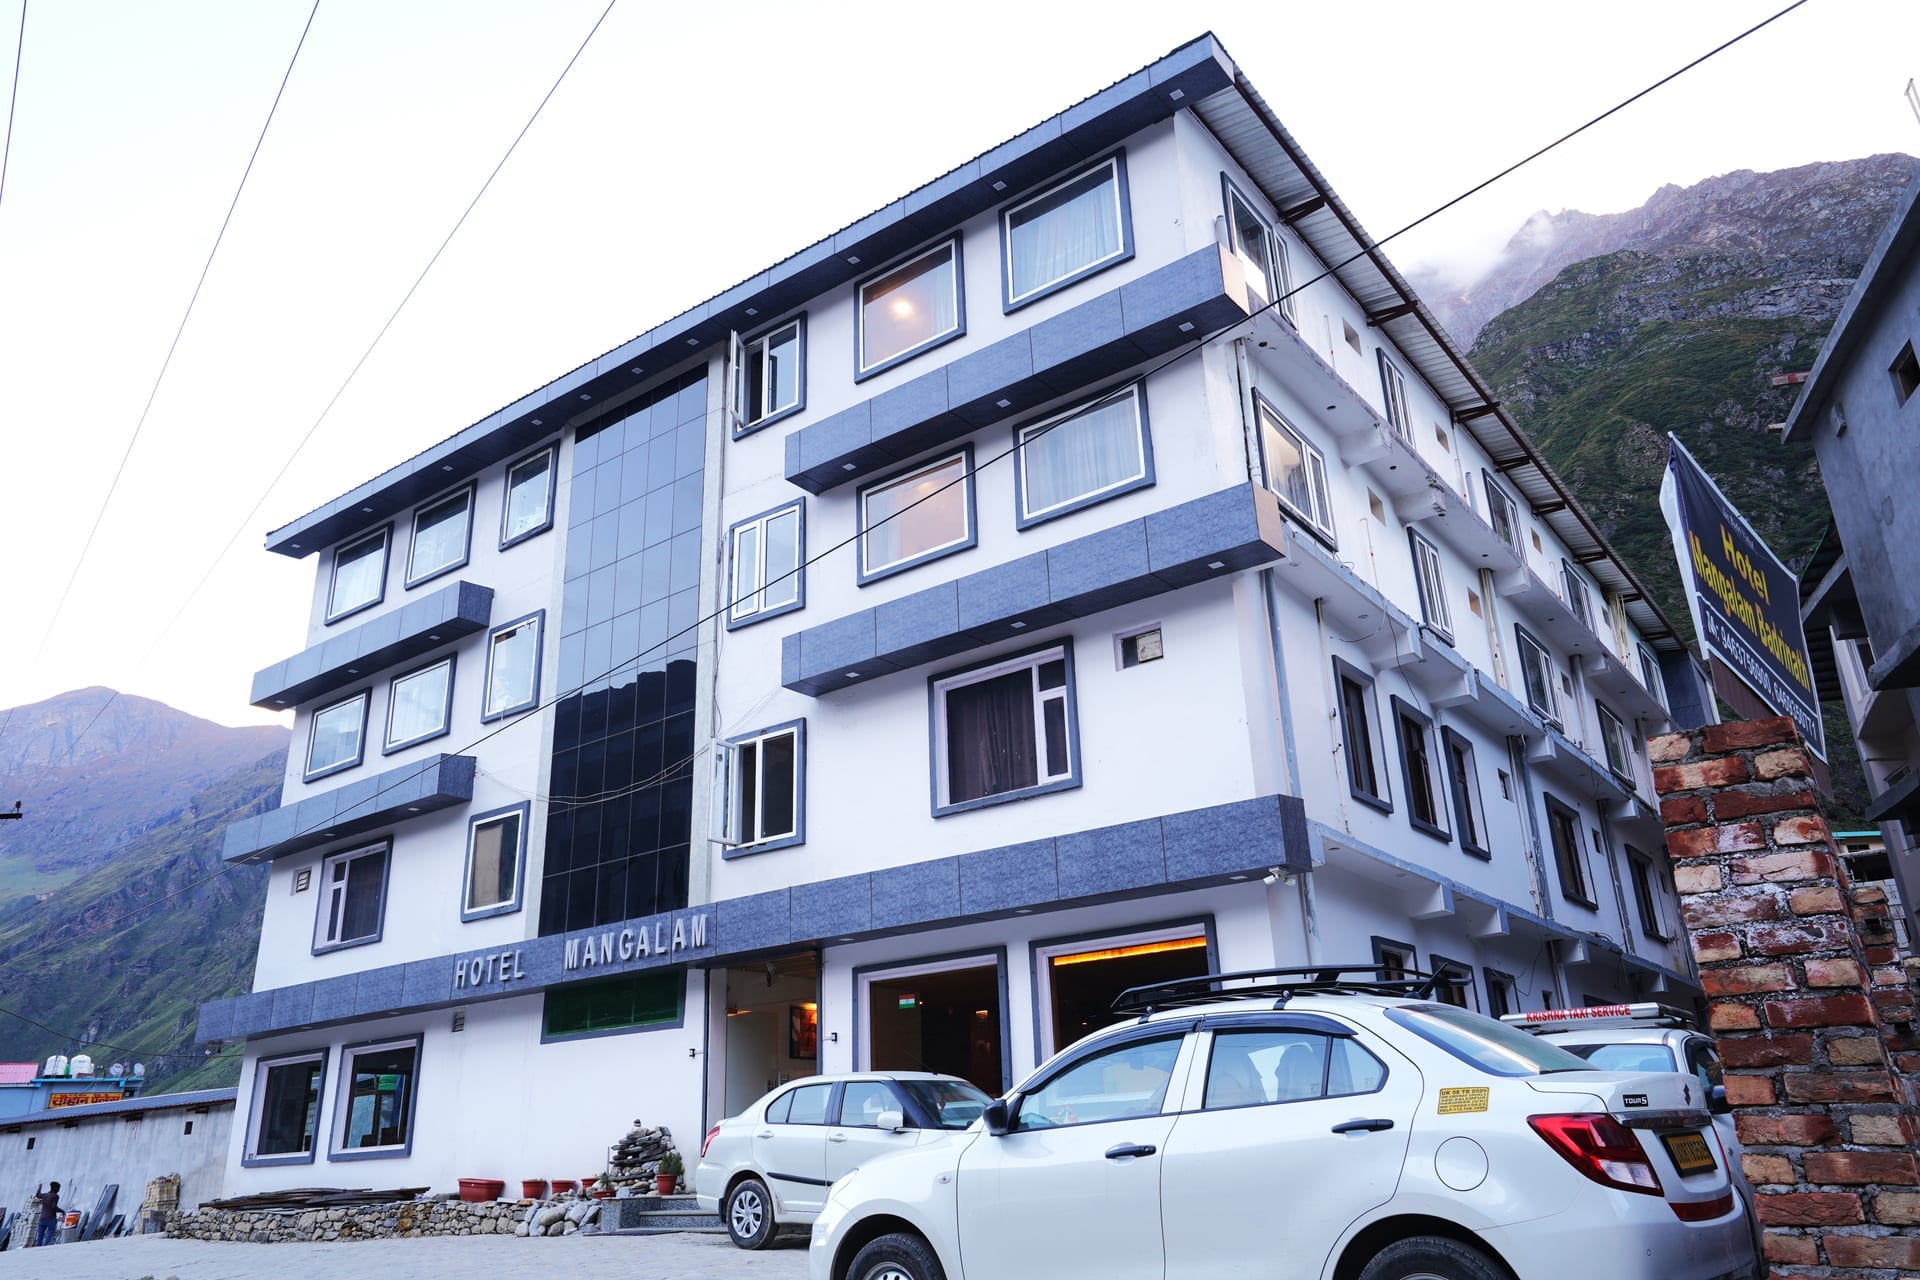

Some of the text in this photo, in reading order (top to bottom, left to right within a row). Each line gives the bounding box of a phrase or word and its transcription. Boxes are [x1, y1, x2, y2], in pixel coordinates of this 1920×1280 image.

[1720, 523, 1771, 606] Hotel
[1689, 529, 1758, 637] Mangalam
[1755, 602, 1811, 693] Badrinath
[455, 913, 708, 988] HOTEL MANGALAM
[1526, 1003, 1632, 1022] KRISHNA TAXI SERVICE
